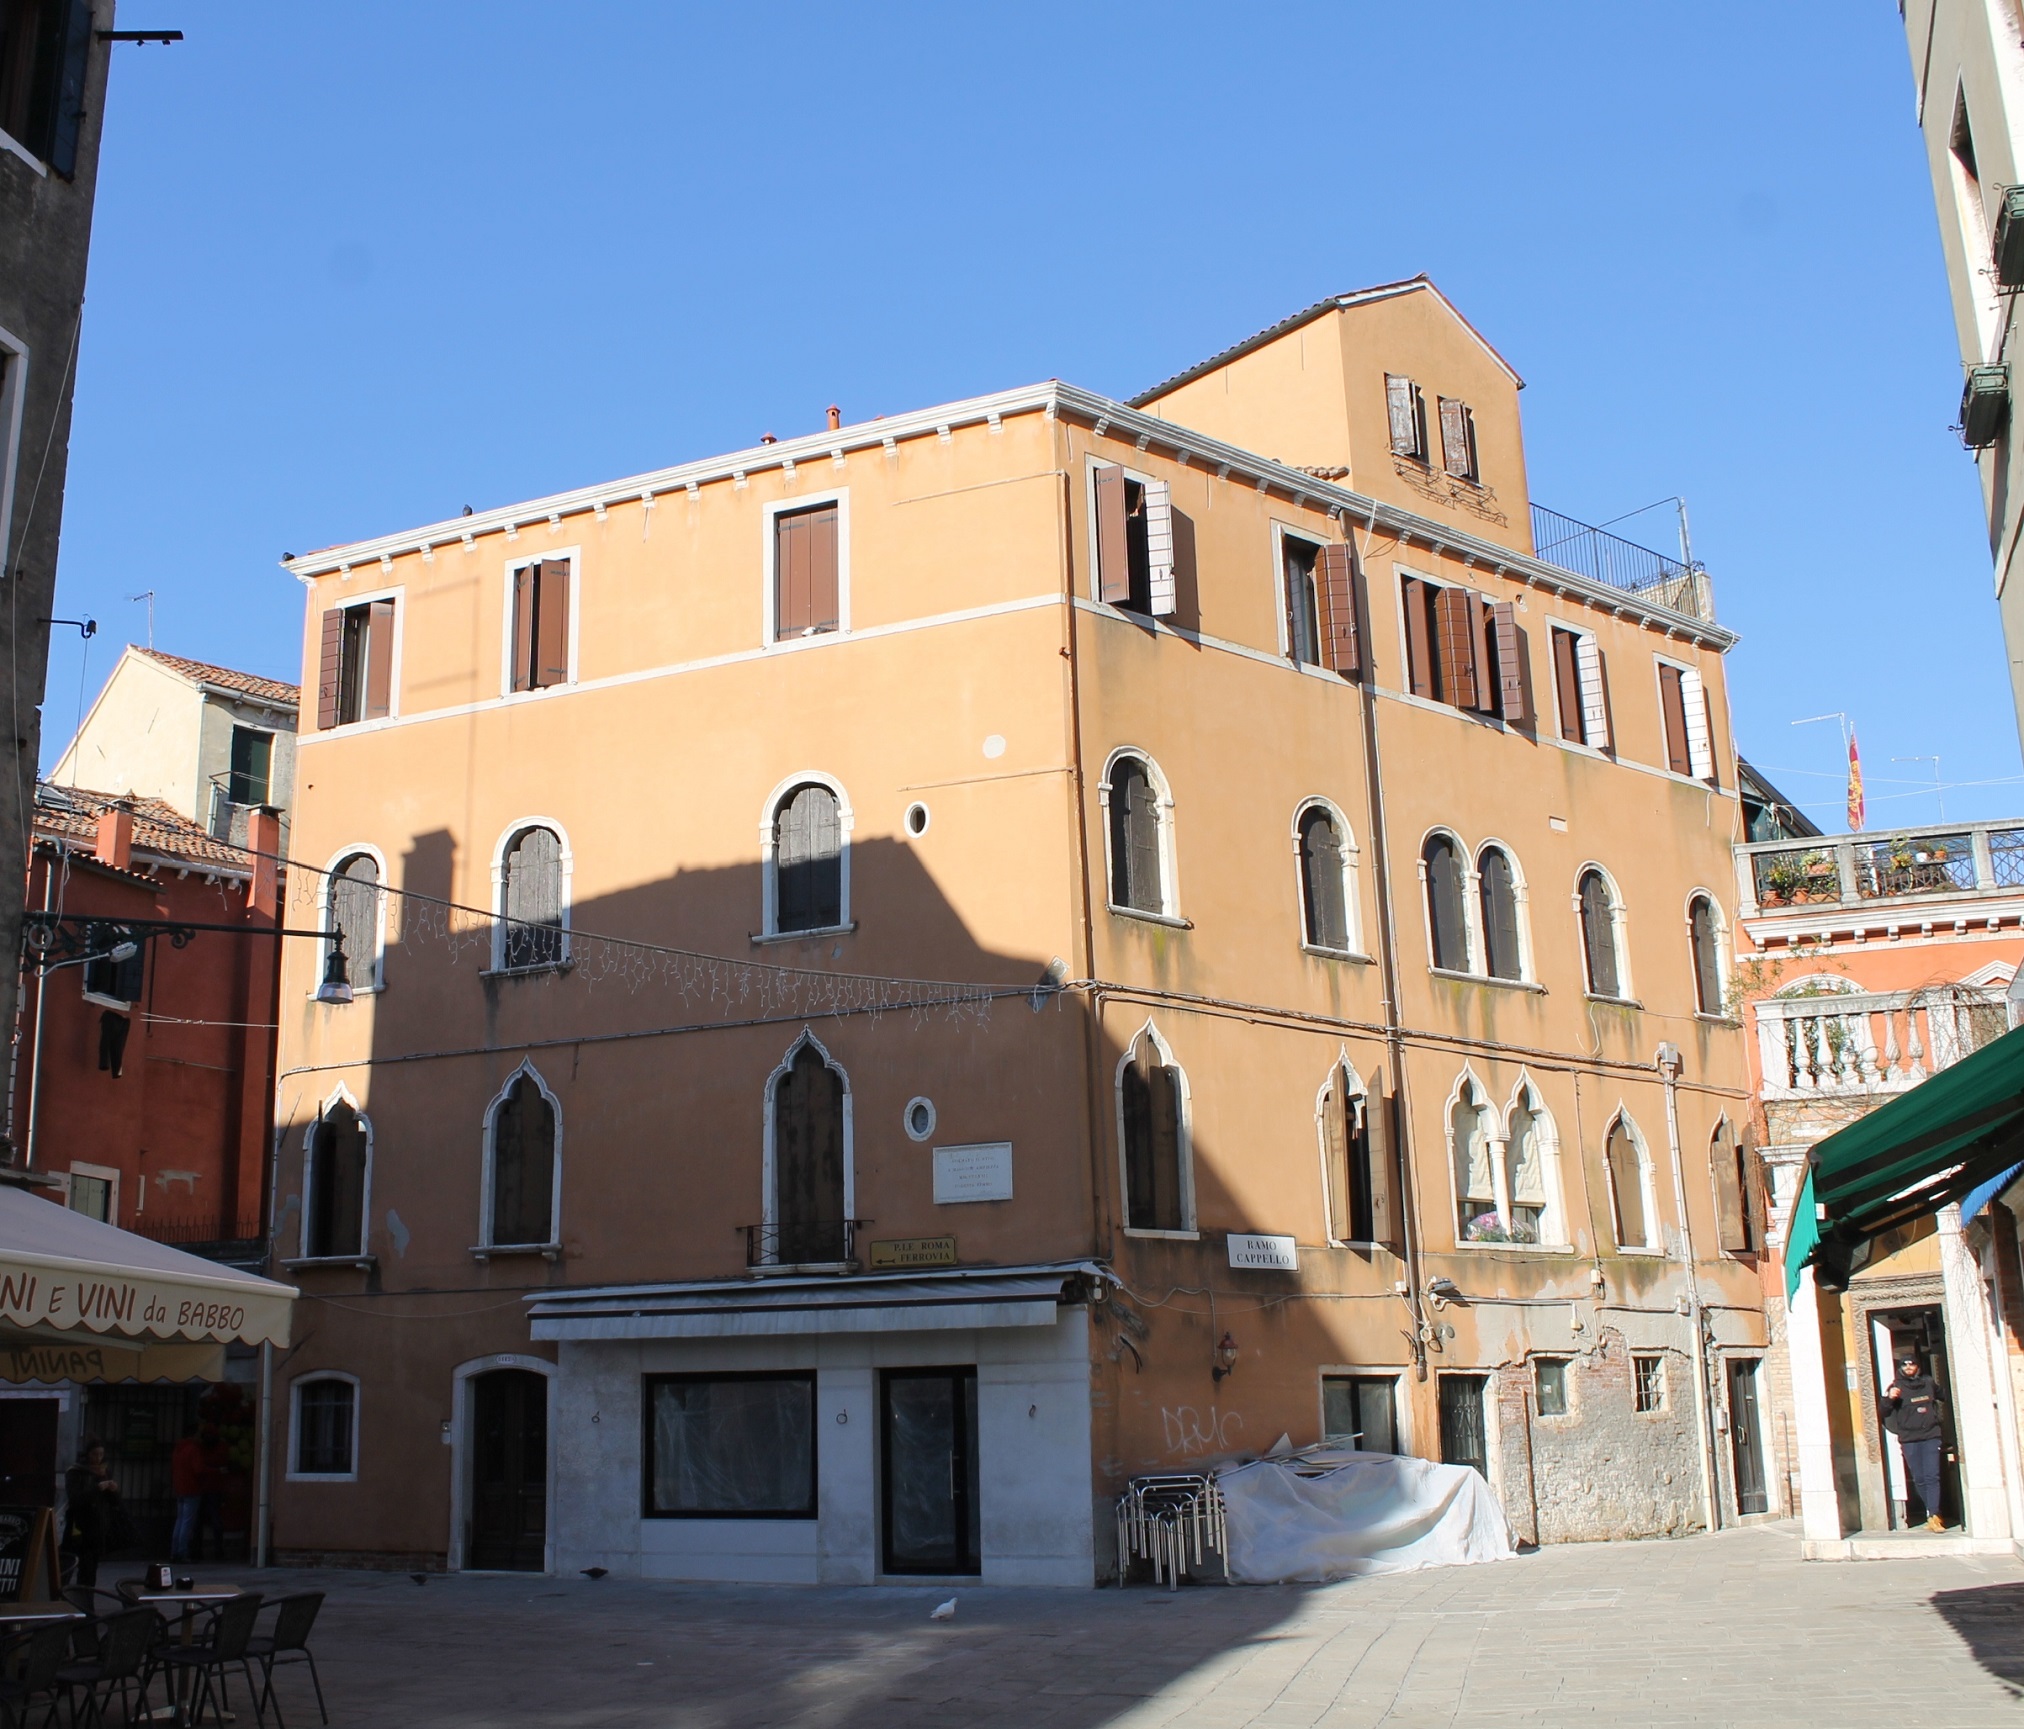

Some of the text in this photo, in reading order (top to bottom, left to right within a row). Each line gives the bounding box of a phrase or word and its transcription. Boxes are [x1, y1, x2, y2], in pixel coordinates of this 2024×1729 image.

[921, 1241, 950, 1250] ROMA
[1247, 1240, 1277, 1251] RAMO
[900, 1252, 950, 1262] FERROVIA
[1236, 1253, 1290, 1265] CAPPELLO
[49, 1286, 66, 1314] E
[78, 1282, 136, 1322] VINI
[143, 1294, 167, 1324] da
[177, 1300, 245, 1331] BABBO
